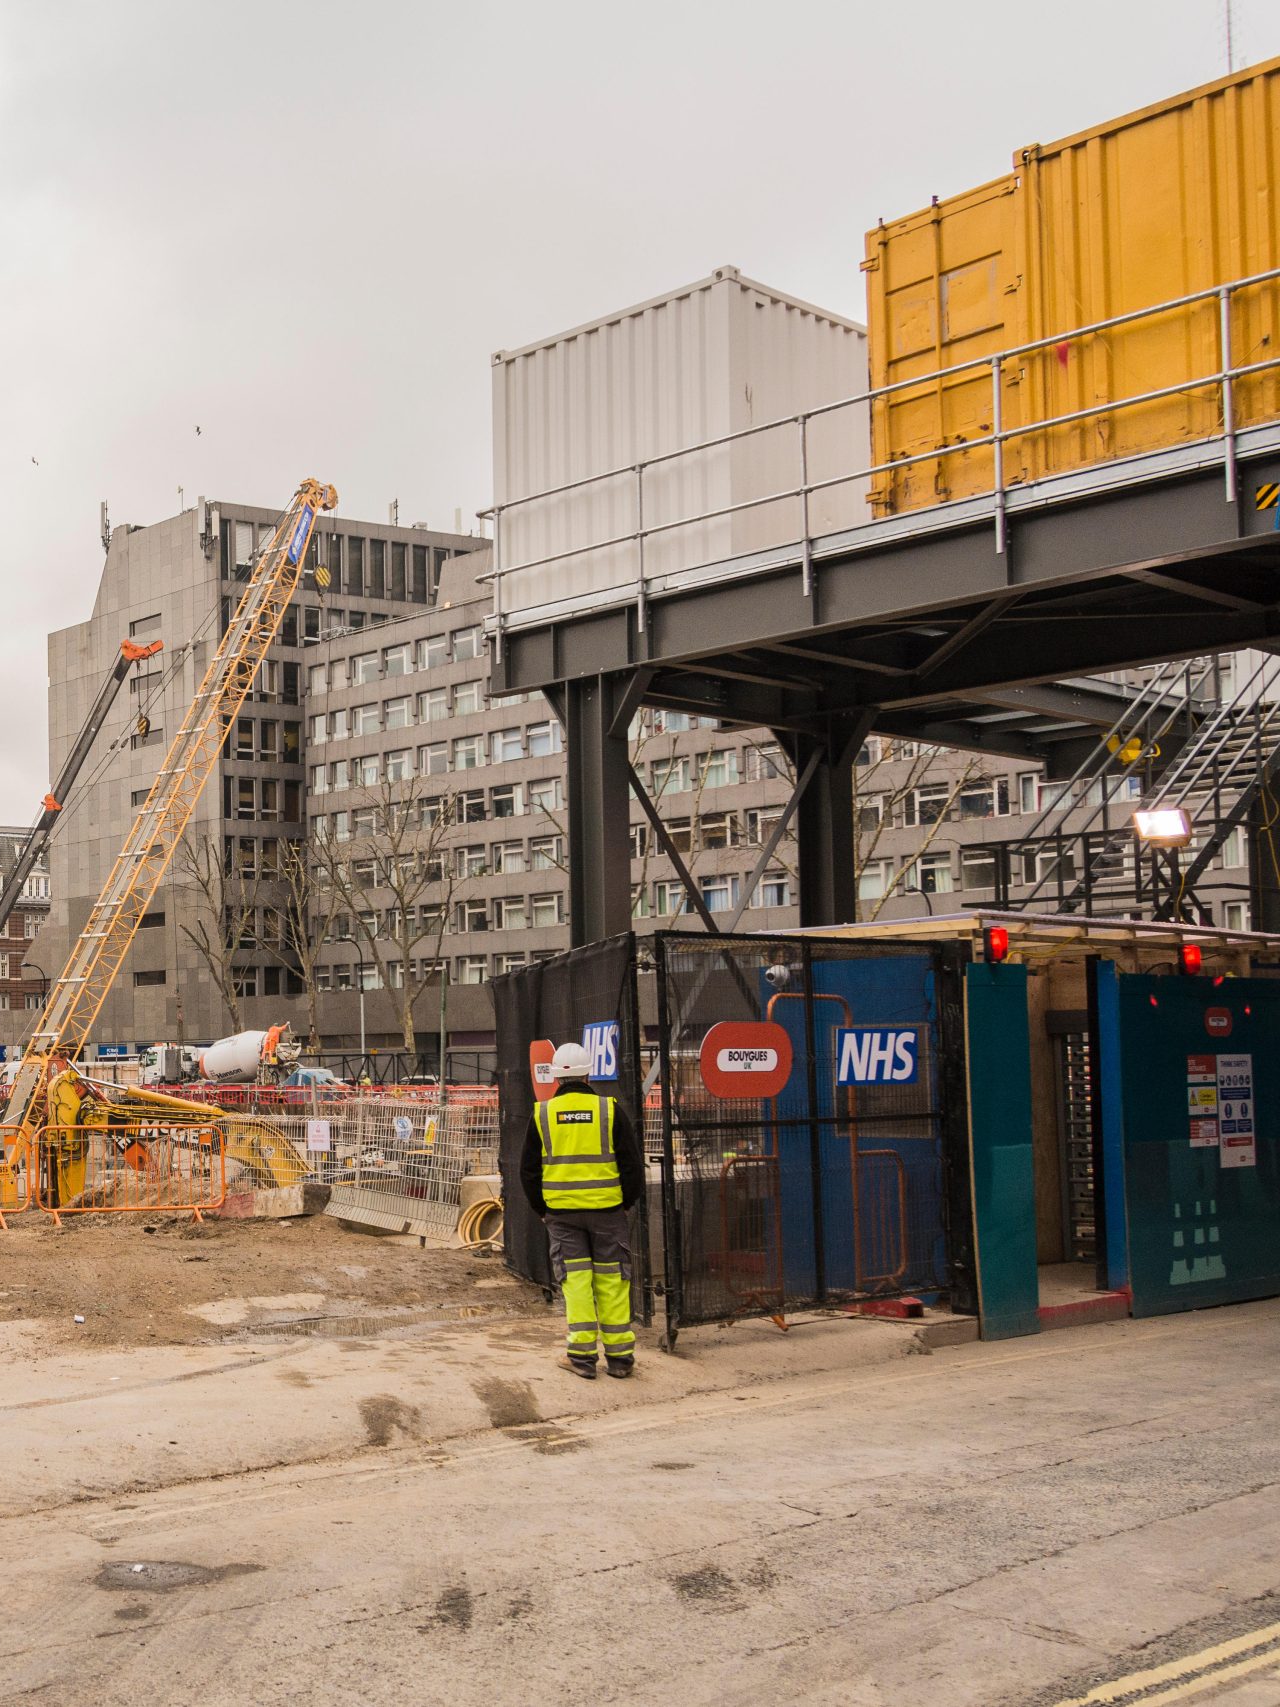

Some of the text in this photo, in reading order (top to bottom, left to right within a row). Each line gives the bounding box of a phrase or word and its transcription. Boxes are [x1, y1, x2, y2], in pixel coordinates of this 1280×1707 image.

[584, 1024, 618, 1076] NHS
[728, 1051, 768, 1062] BOUYGUES
[839, 1031, 915, 1081] NHS
[743, 1062, 752, 1070] UK
[216, 1068, 243, 1079] Hanson
[563, 1112, 591, 1121] McGEE
